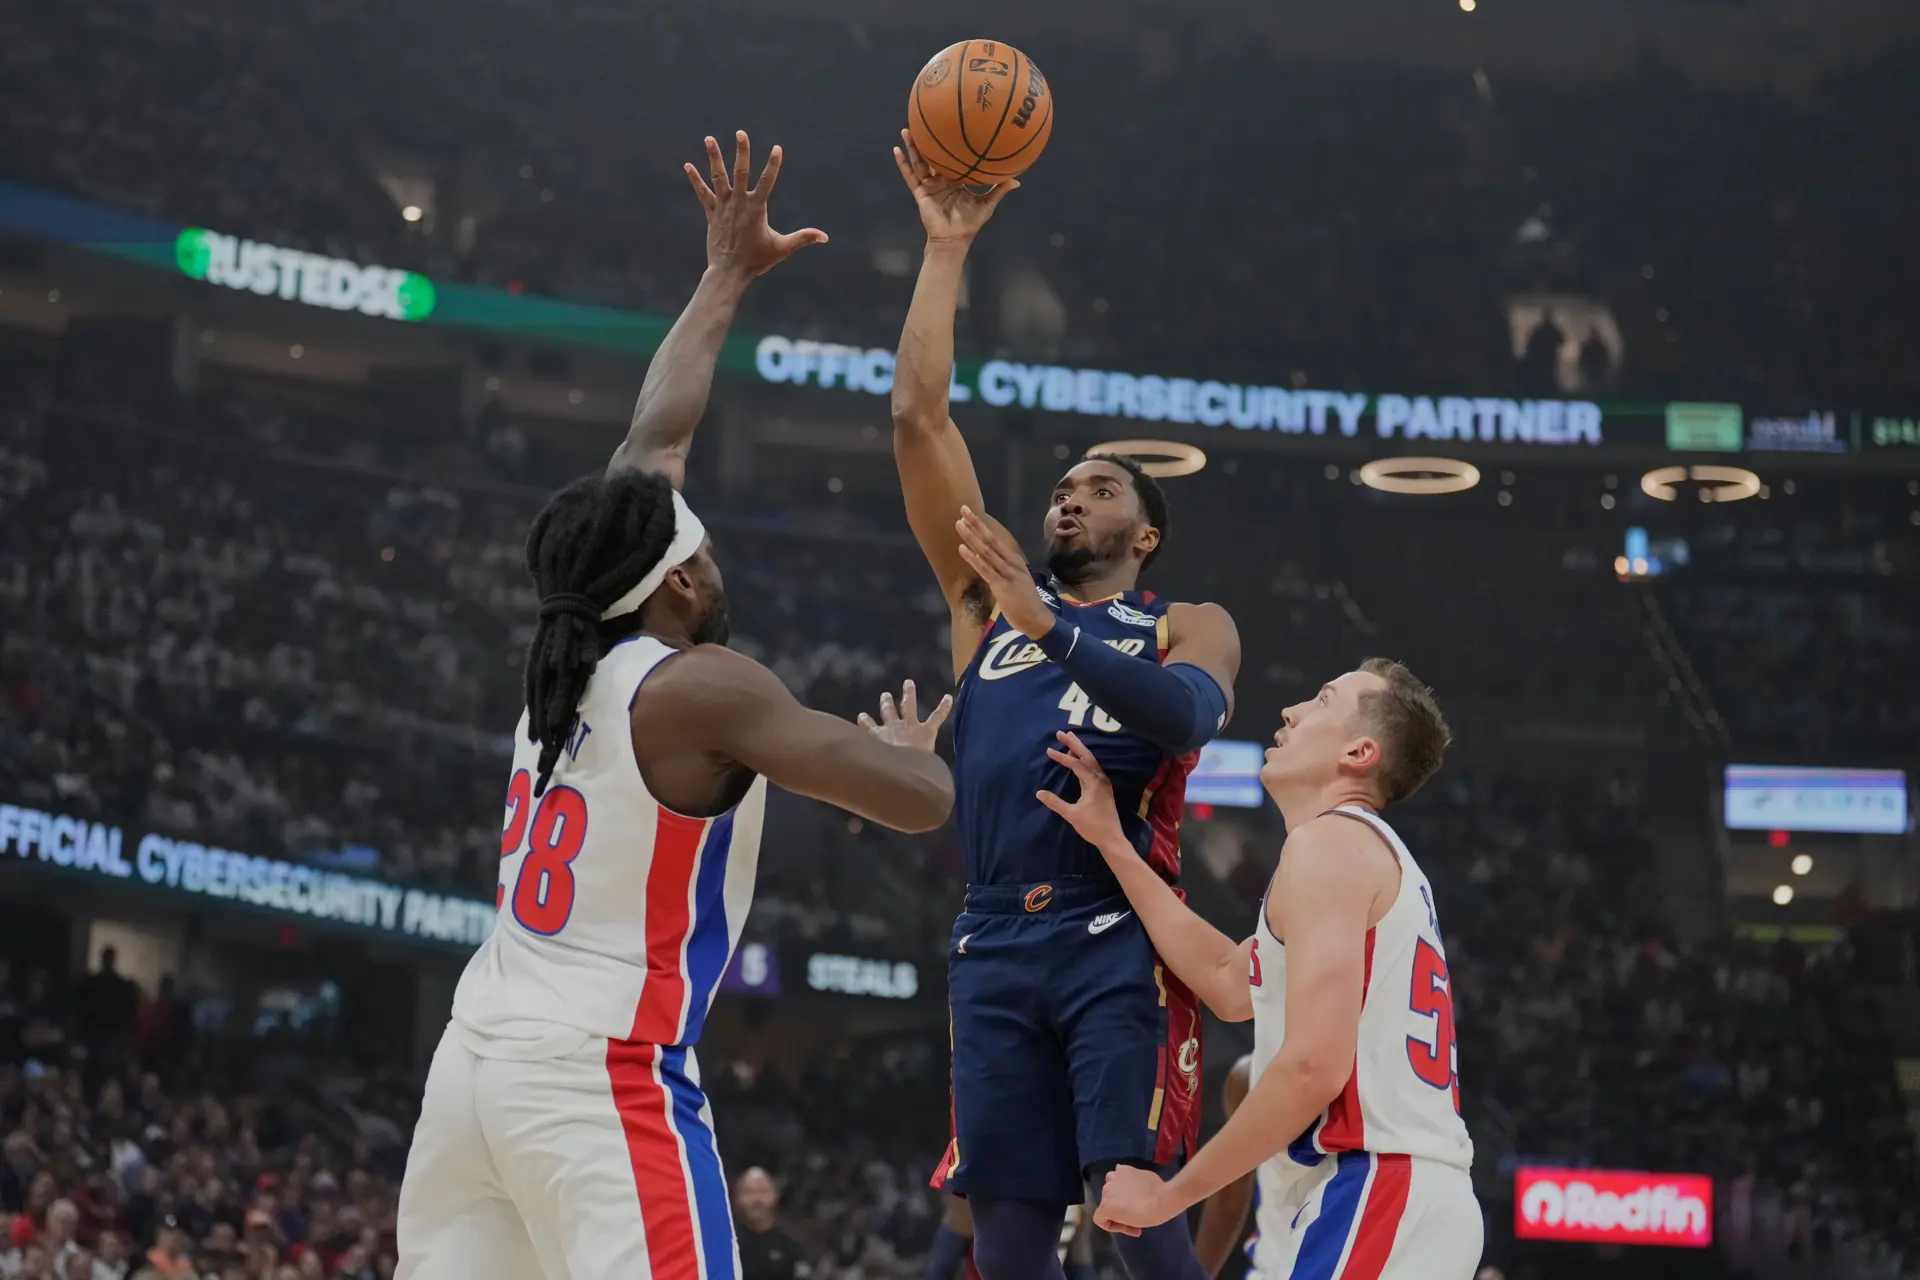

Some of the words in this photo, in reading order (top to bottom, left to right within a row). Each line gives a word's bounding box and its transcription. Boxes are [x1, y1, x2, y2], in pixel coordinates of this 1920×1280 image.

[756, 335, 971, 402] OFFICL
[978, 359, 1366, 437] CYBERSECURITY
[1376, 393, 1603, 445] PARTNER
[0, 804, 132, 877] FFICIAL
[138, 832, 403, 931] CYBERSECURITY
[1093, 911, 1120, 926] NIKE
[808, 953, 918, 999] STEALS
[1405, 934, 1460, 1115] 5
[1564, 1181, 1707, 1235] Redfin
